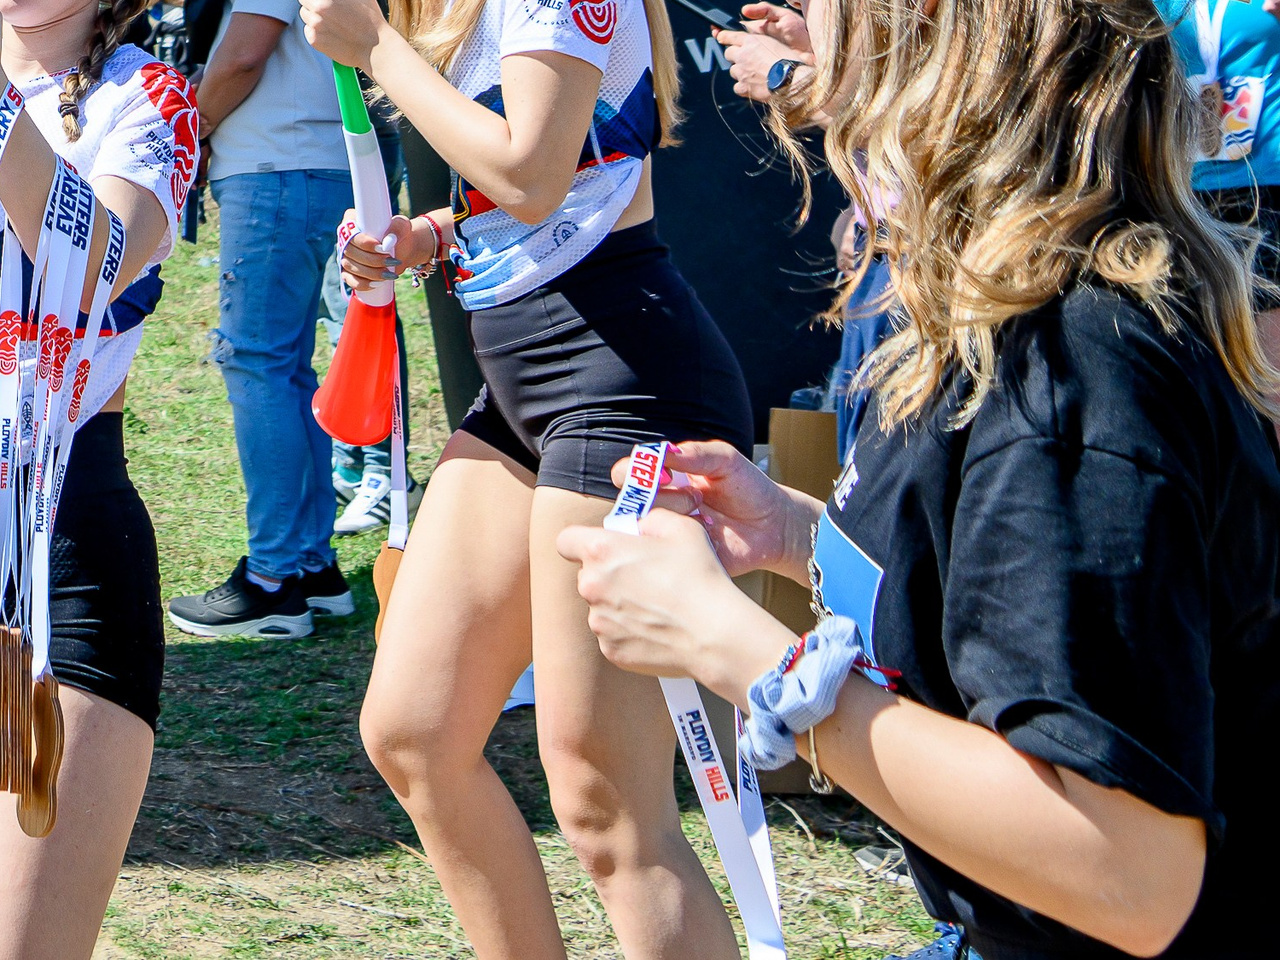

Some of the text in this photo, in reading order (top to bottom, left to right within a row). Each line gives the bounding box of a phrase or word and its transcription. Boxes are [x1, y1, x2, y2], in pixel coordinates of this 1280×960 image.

[145, 143, 170, 165] HILLS
[56, 167, 79, 237] EVERY
[72, 176, 93, 251] ATTERS
[0, 418, 12, 490] PLOVDIV HILLS
[630, 450, 660, 489] STEP
[53, 462, 67, 505] PLOVDIV
[685, 709, 731, 803] PLOVDIV HILLS
[739, 754, 754, 794] PLOV
